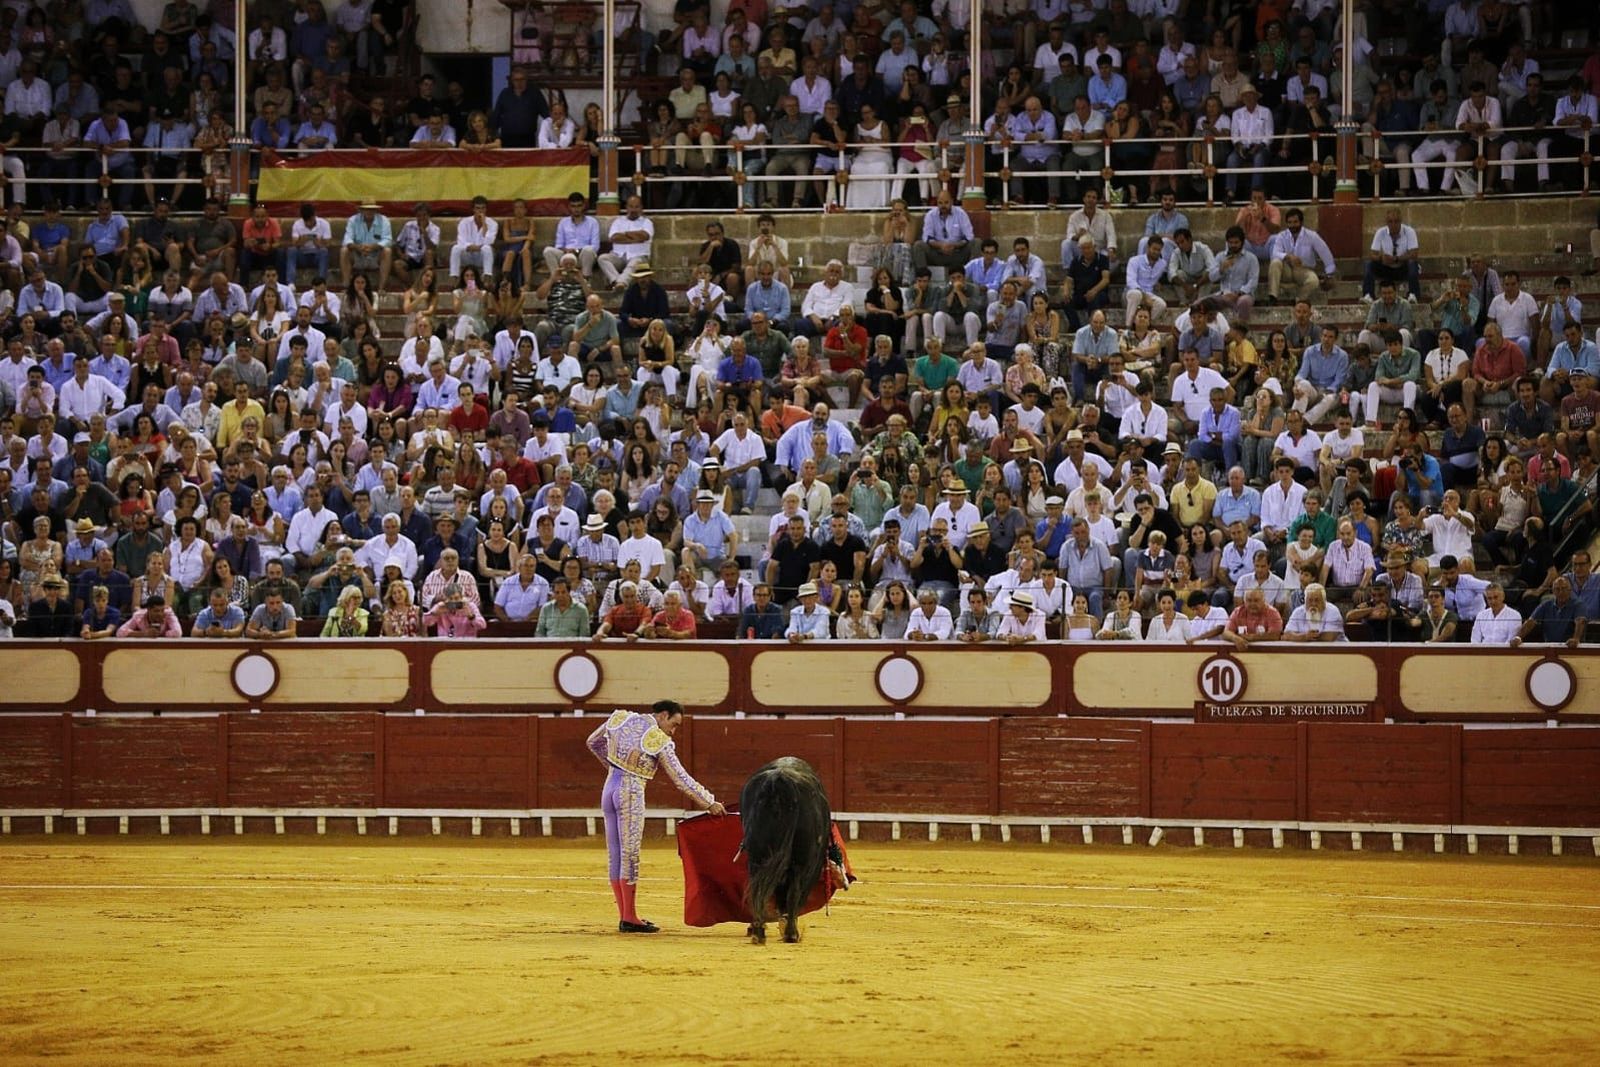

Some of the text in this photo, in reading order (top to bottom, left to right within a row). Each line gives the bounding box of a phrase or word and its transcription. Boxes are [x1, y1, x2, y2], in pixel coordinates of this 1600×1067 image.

[1206, 666, 1235, 695] 10
[1211, 704, 1365, 716] FUERZAS DE SEGUIRIDAD
